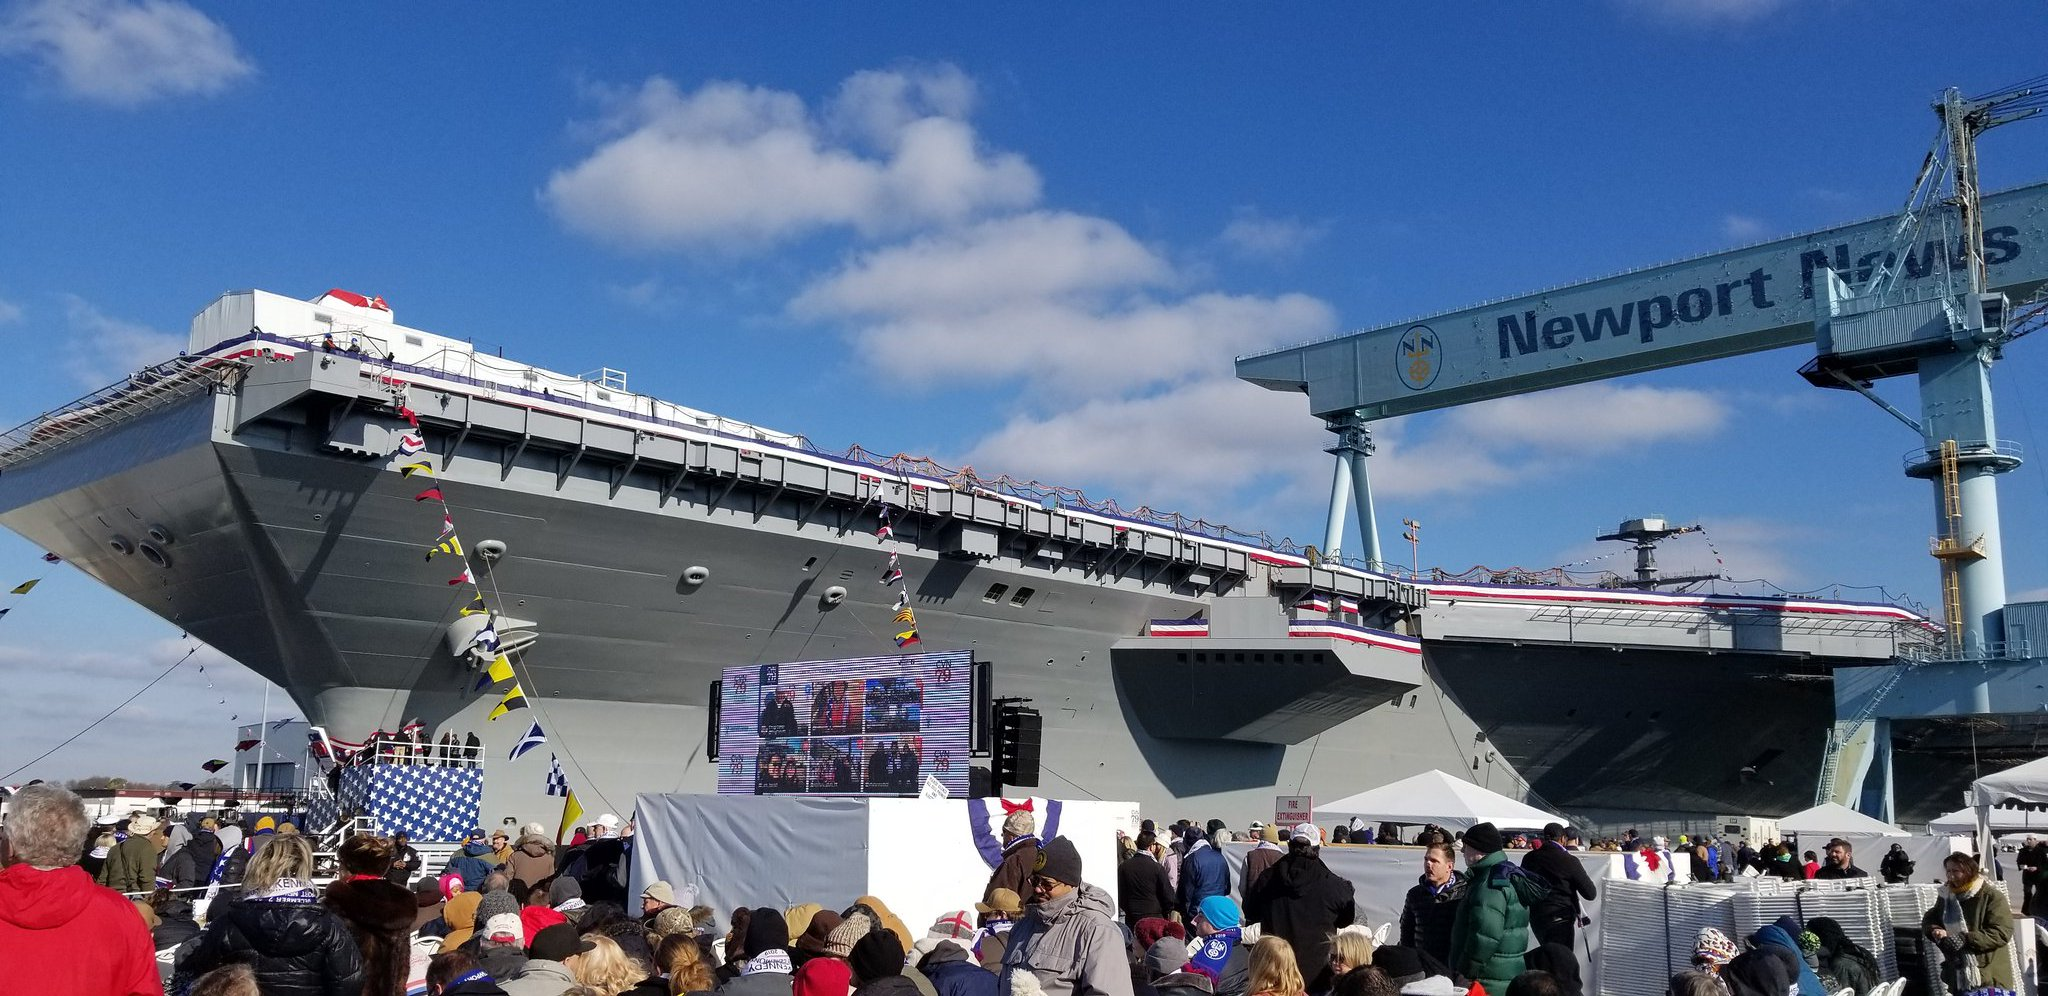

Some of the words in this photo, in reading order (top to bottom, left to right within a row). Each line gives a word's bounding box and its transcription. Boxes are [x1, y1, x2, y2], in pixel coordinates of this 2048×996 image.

[1497, 266, 1776, 359] Newport
[1799, 225, 2022, 300] News
[1288, 800, 1298, 809] FIRE
[1277, 812, 1309, 821] EXTINGUISHER
[748, 962, 791, 972] KENNEDY
